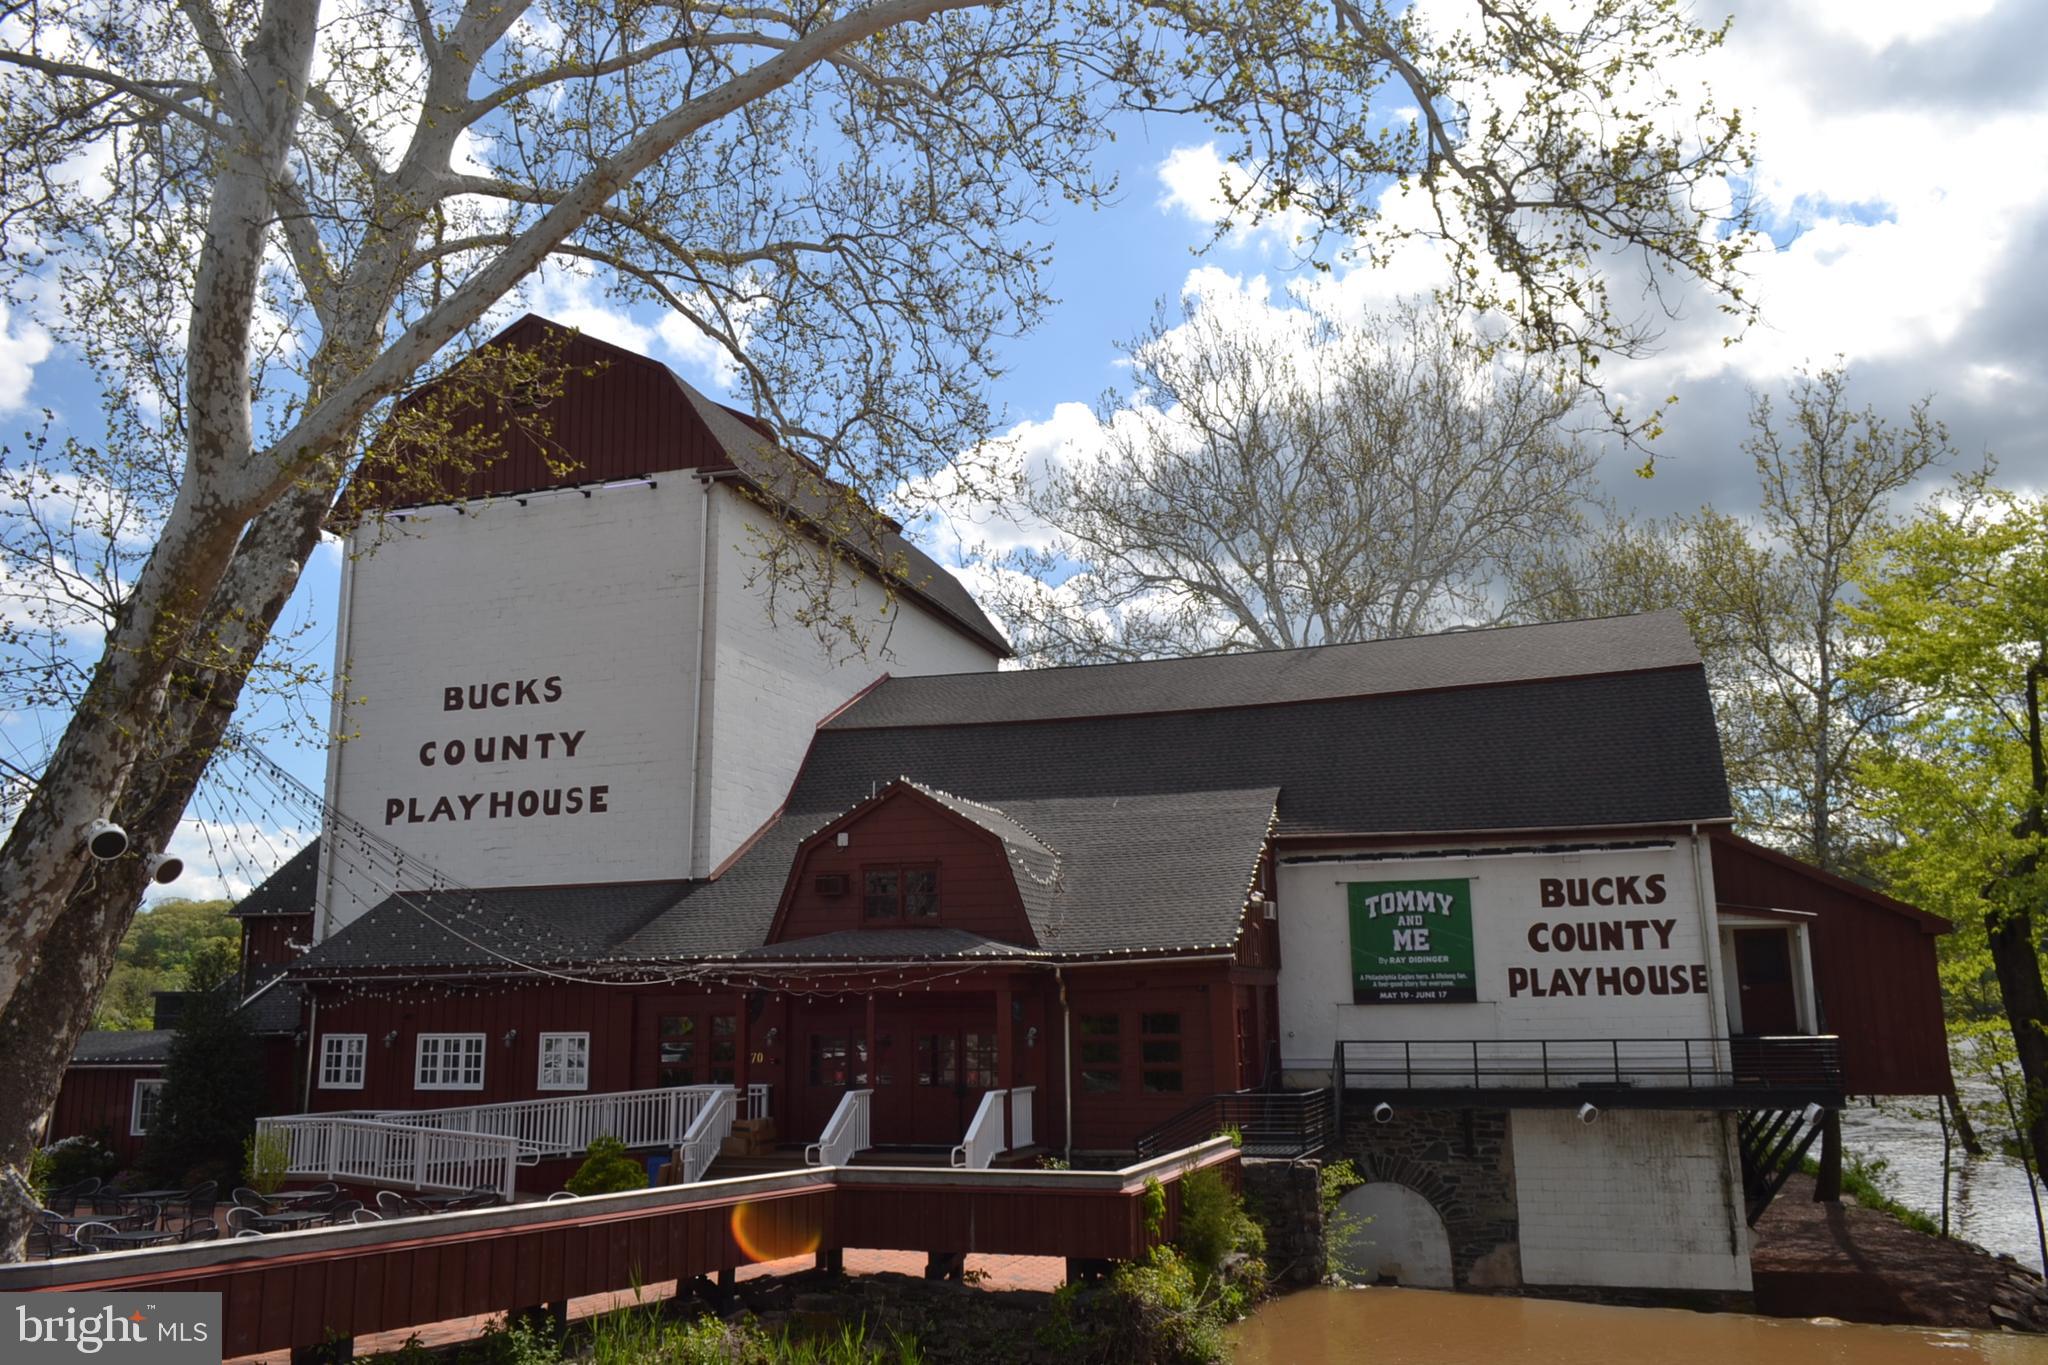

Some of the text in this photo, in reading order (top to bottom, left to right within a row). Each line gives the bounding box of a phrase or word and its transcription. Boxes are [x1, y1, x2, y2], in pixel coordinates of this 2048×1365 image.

[443, 675, 563, 712] BUCKS
[419, 730, 586, 767] COUNTY
[385, 785, 609, 826] PLAYHOUSE
[1365, 890, 1454, 919] TOMMY
[1539, 873, 1668, 908] BUCKS
[1397, 914, 1423, 927] AND
[1527, 918, 1677, 953] COUNTY
[1392, 928, 1431, 952] ME
[1389, 956, 1407, 964] RAY
[1408, 955, 1449, 964] DIDINGER
[1400, 991, 1409, 999] 19
[1415, 991, 1436, 999] JUNE
[1438, 990, 1448, 999] 17
[1507, 964, 1710, 998] PLAYHOUSE
[751, 1052, 764, 1064] 70
